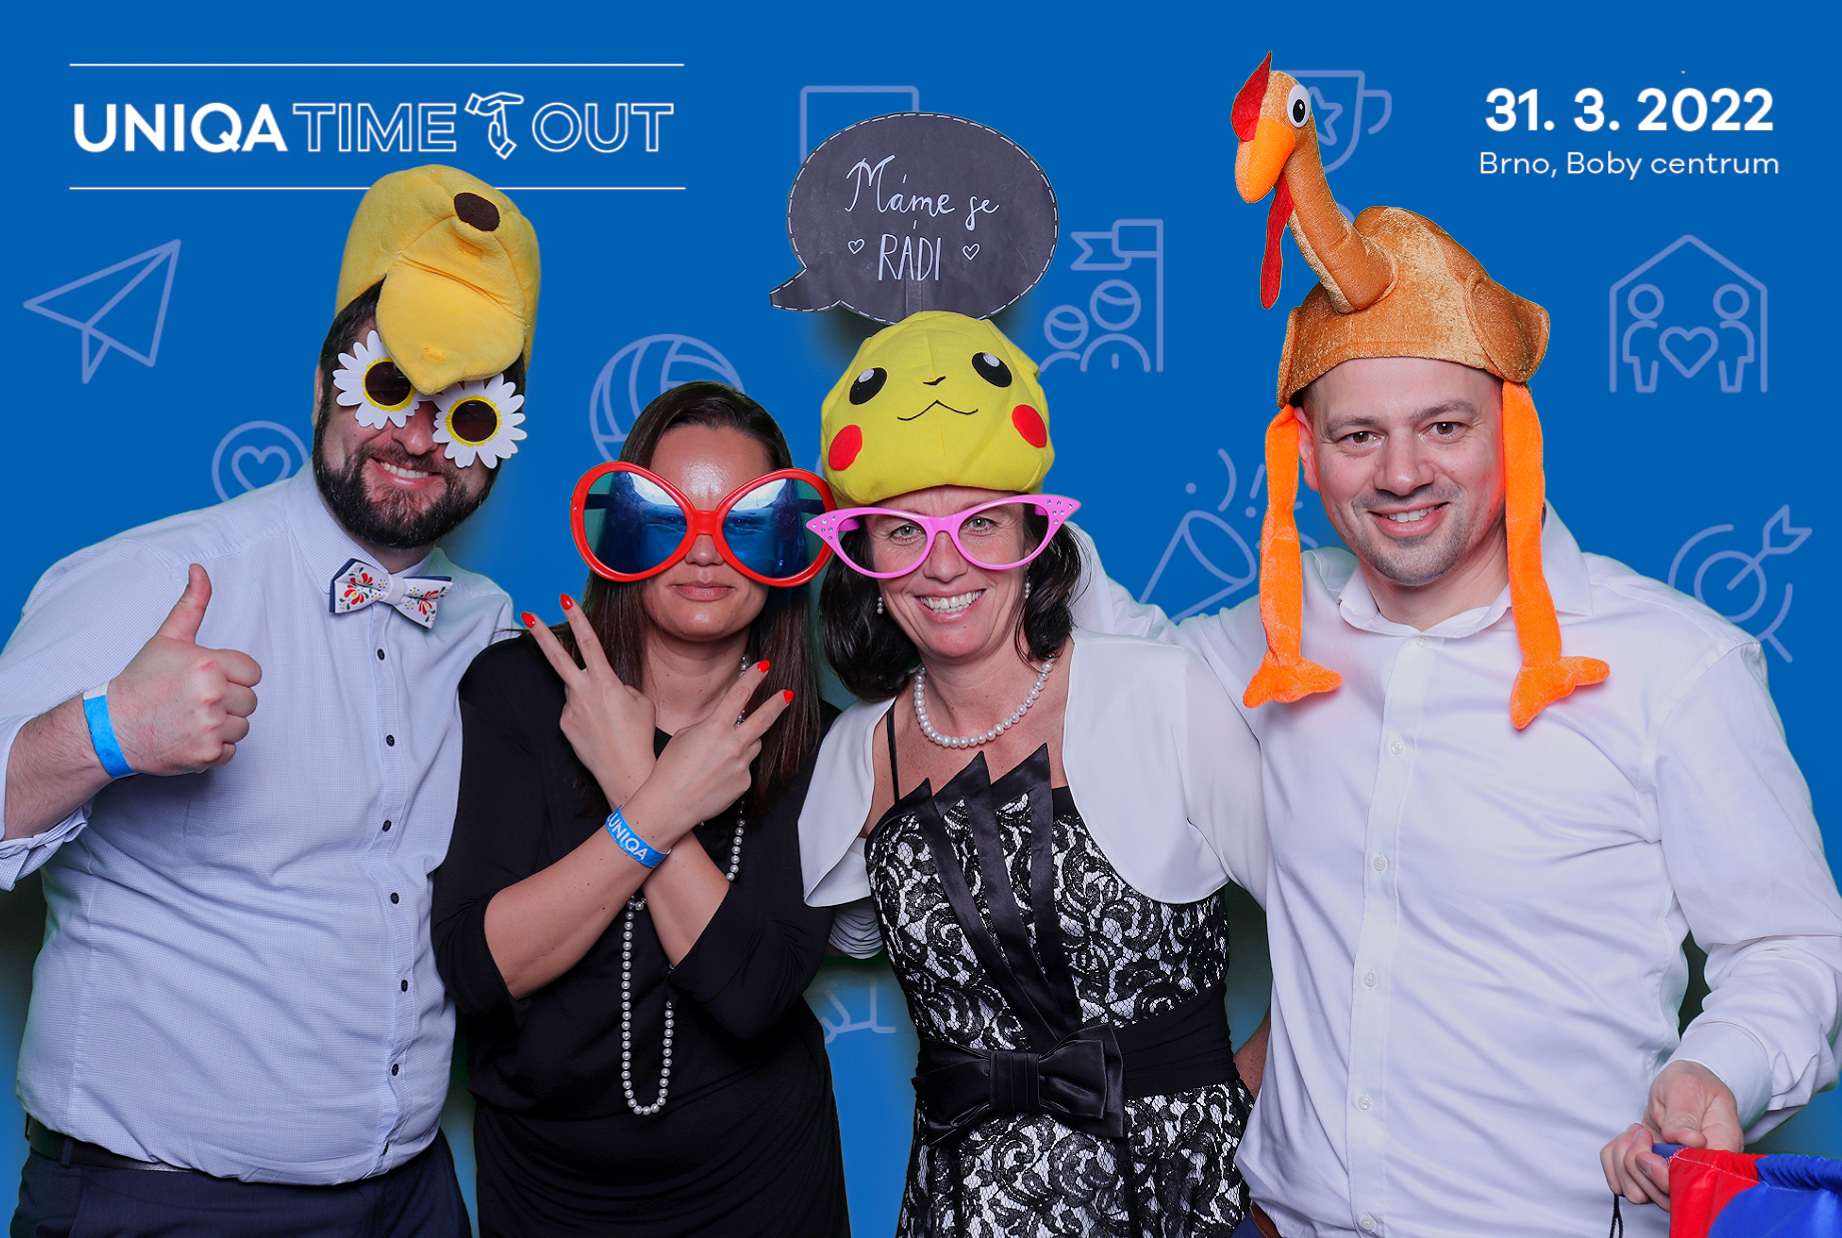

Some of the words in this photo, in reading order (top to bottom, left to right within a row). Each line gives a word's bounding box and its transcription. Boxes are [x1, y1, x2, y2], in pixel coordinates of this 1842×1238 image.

[845, 155, 955, 216] Máme
[965, 195, 1000, 231] se
[878, 219, 942, 281] RÁDI
[608, 812, 648, 861] UNIQA
